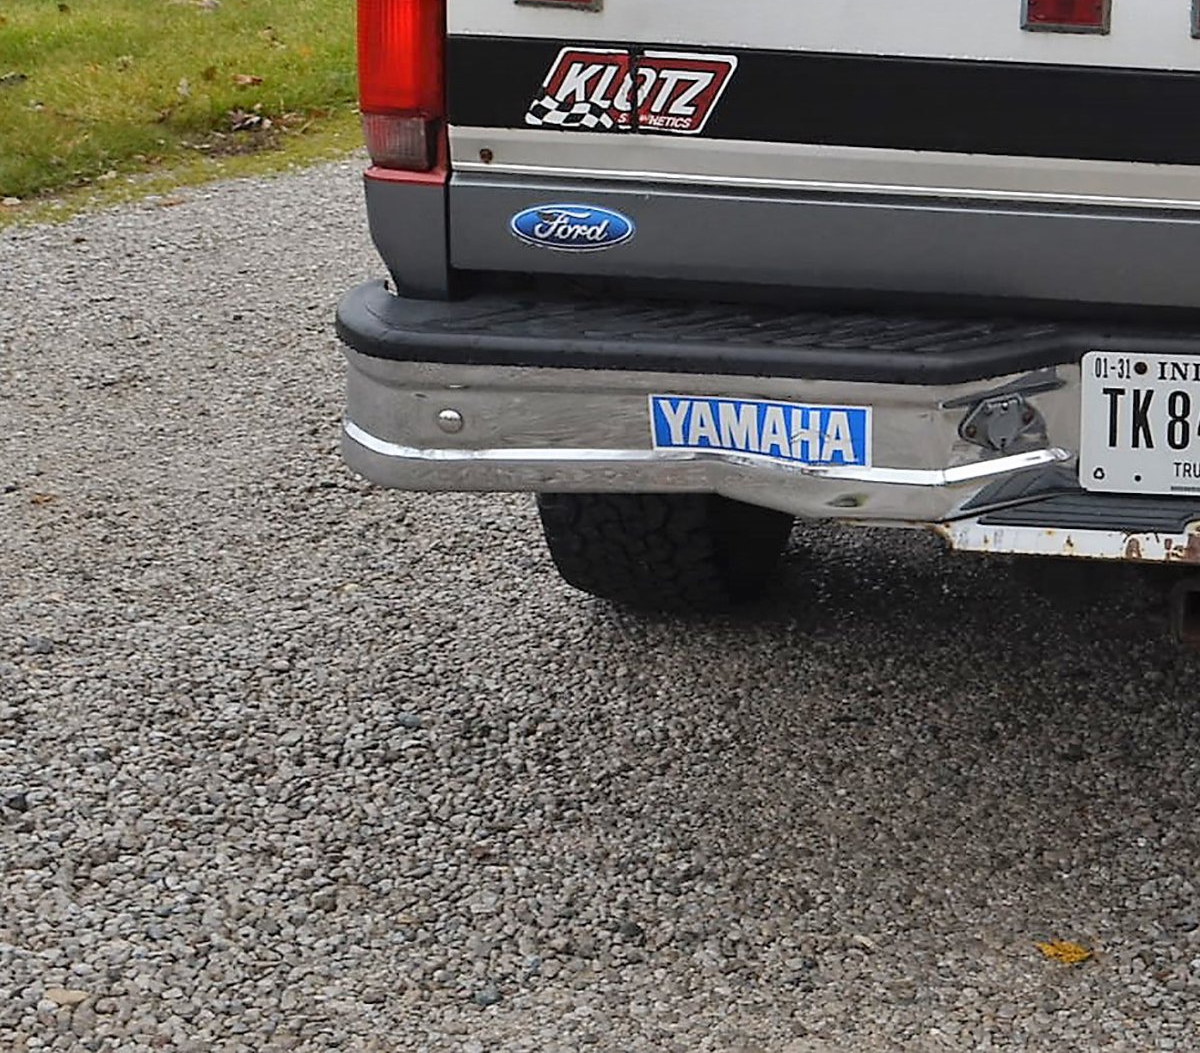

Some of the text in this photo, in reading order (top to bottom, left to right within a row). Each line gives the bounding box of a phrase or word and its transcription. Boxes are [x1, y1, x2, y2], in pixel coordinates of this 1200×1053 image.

[555, 62, 715, 116] KLOTZ
[534, 208, 610, 241] Ford
[1094, 357, 1132, 380] 01-31
[658, 399, 859, 463] YAMAHA
